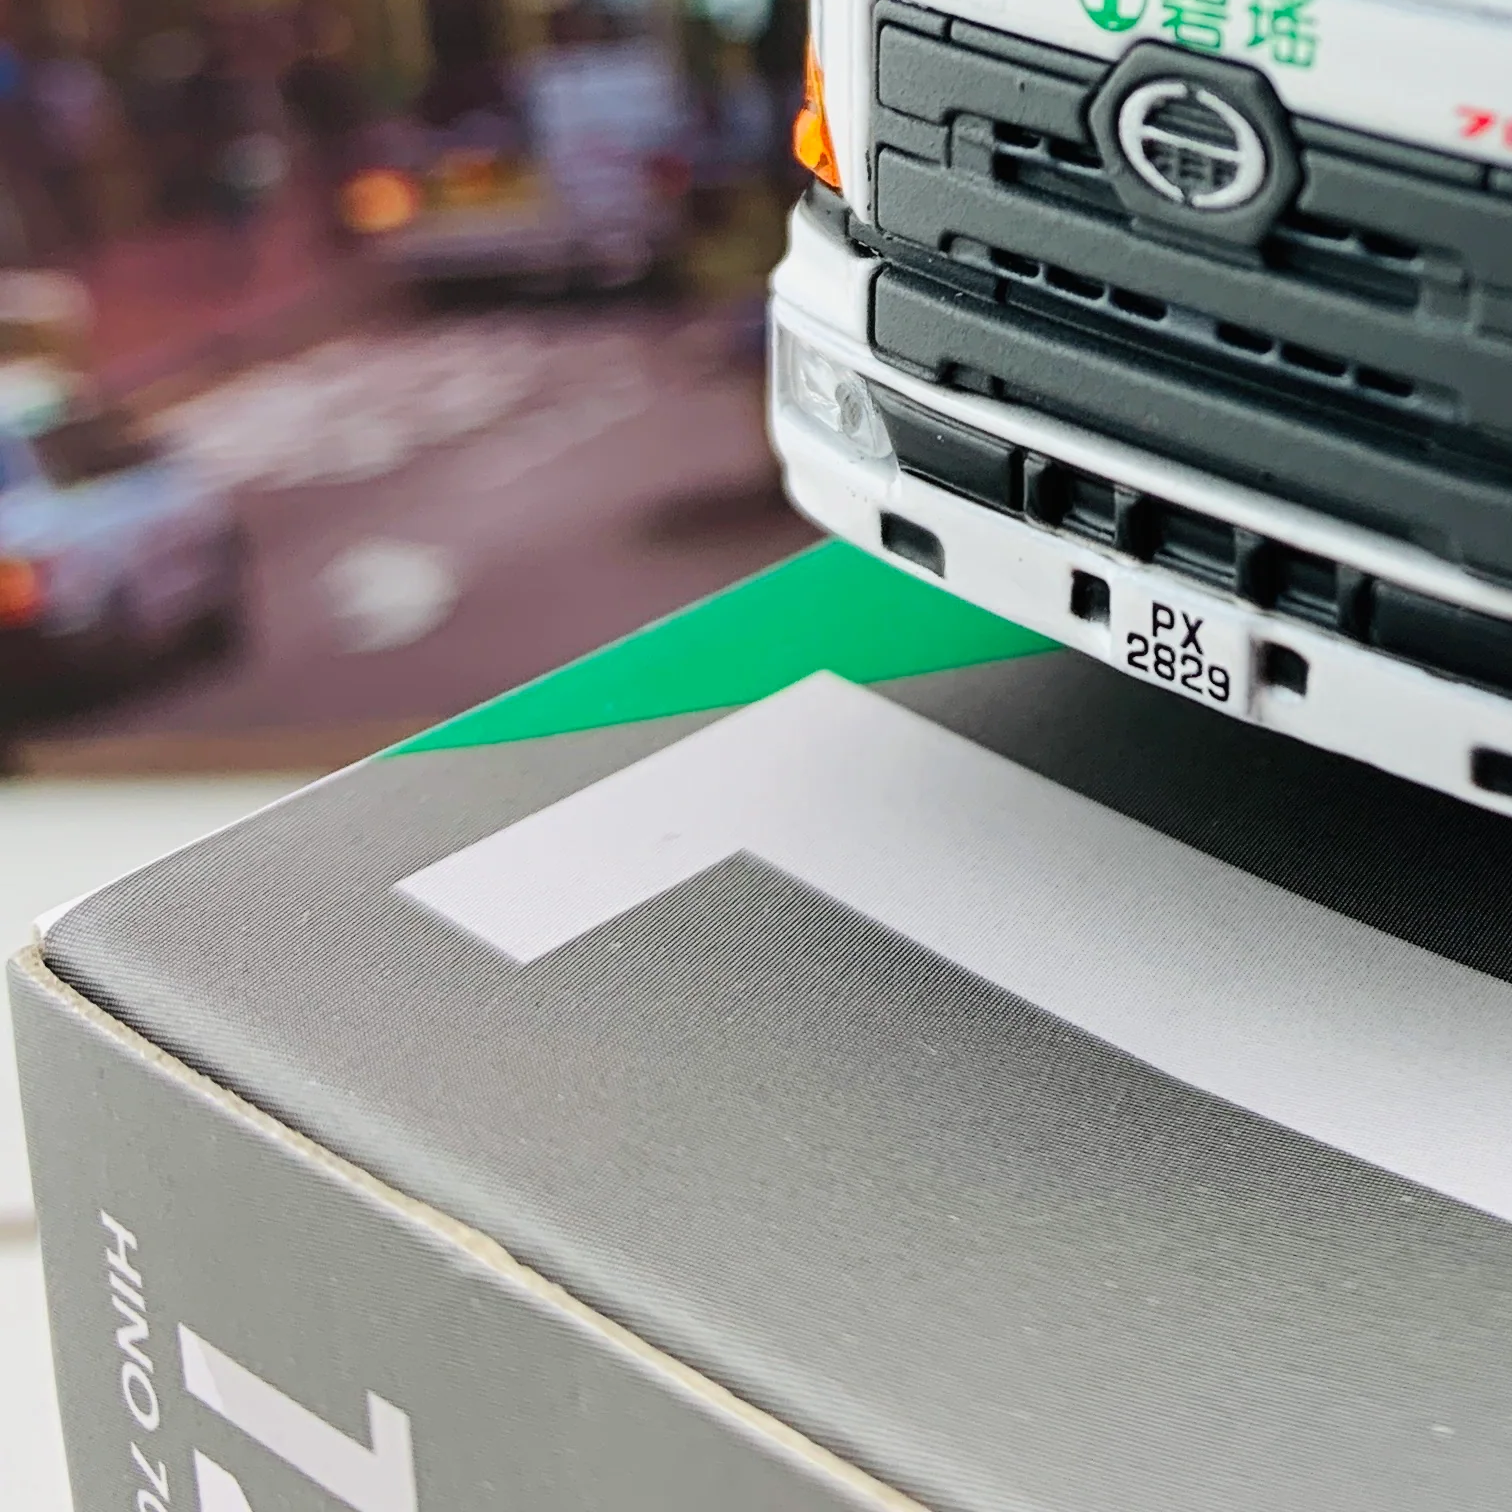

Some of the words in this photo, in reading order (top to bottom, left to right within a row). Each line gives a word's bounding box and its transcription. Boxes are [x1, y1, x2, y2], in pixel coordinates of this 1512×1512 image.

[1151, 600, 1203, 655] PX
[1126, 631, 1230, 702] 2829
[100, 1208, 160, 1432] HINO
